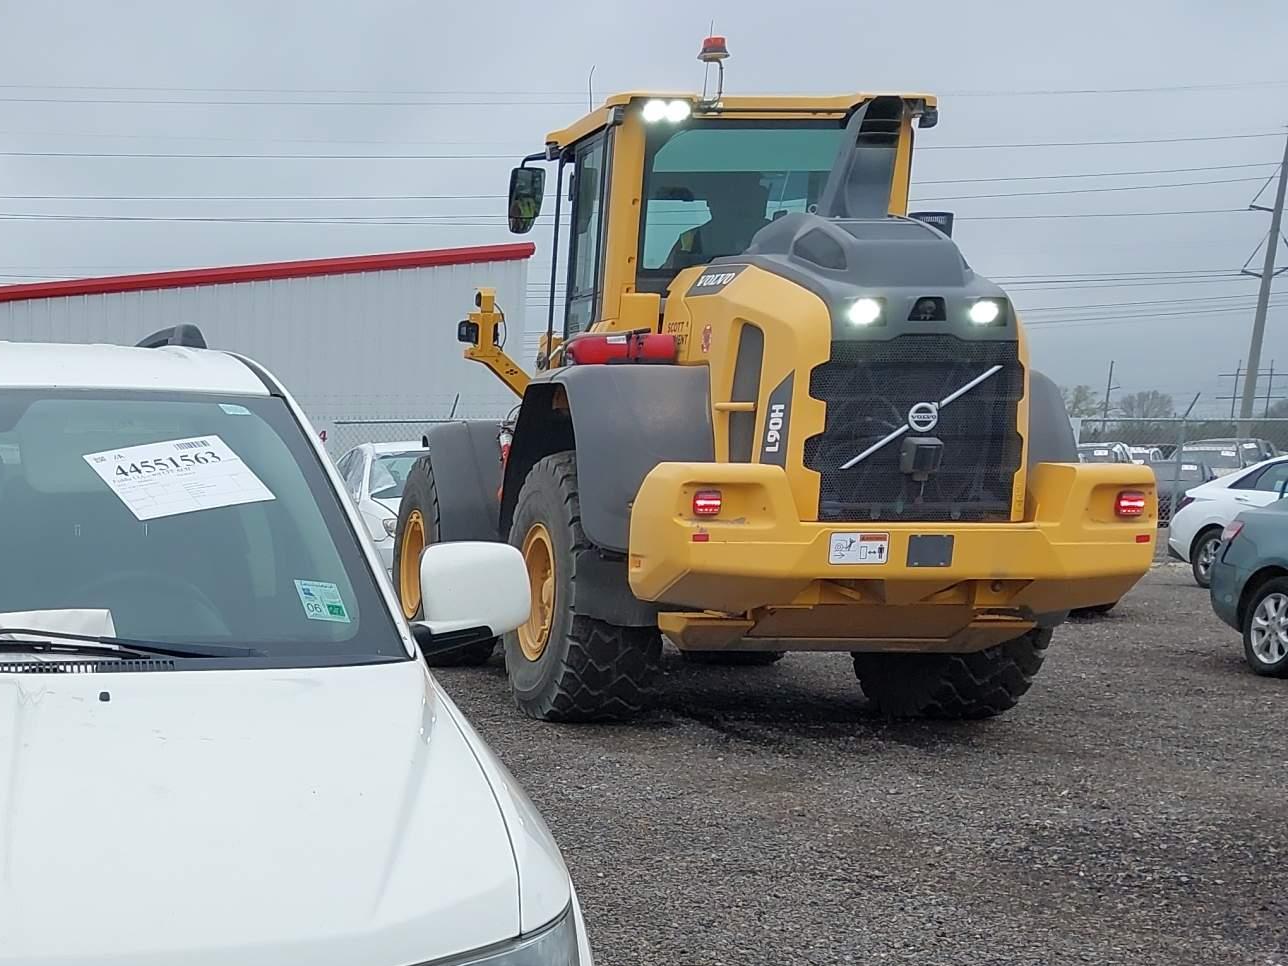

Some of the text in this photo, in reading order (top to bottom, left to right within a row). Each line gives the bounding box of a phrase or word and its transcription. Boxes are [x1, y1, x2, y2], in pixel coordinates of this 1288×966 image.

[696, 272, 736, 287] VOLVO
[765, 404, 785, 452] L90H
[114, 451, 222, 477] 44551563
[306, 602, 322, 613] 06
